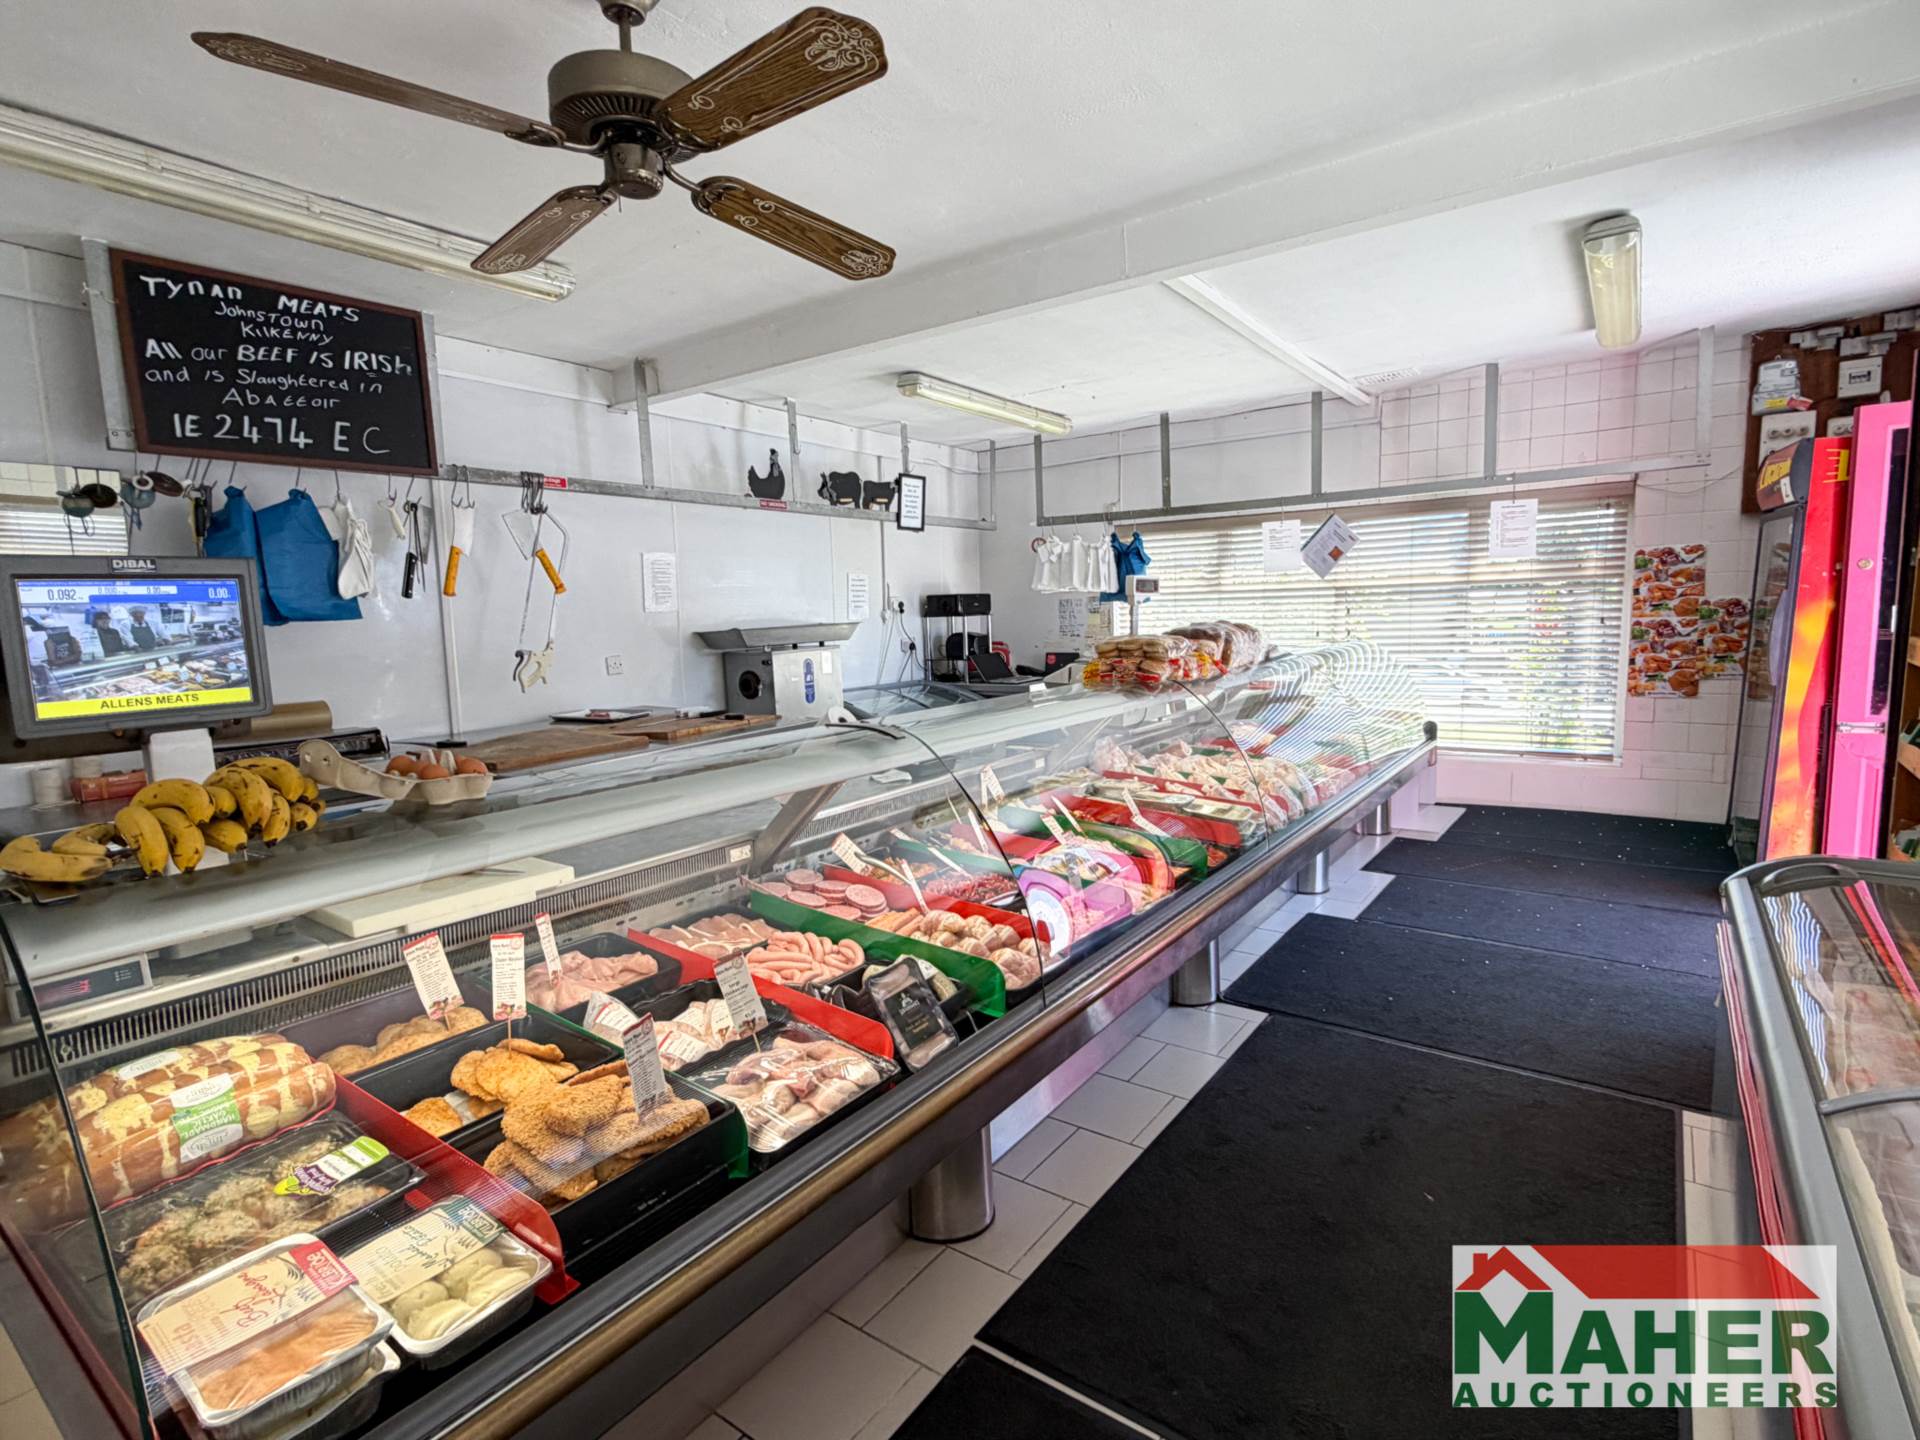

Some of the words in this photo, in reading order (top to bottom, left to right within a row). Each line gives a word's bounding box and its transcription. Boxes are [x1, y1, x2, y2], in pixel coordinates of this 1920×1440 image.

[277, 295, 360, 322] MEATS
[145, 338, 182, 360] All
[191, 346, 228, 361] our
[236, 343, 299, 363] BEEF
[145, 366, 190, 382] and
[236, 368, 349, 391] Slaughtered
[360, 382, 382, 394] in
[213, 413, 313, 449] 2474
[333, 420, 351, 452] E
[362, 426, 390, 454] C
[112, 559, 155, 570] DIBAL
[48, 589, 77, 601] 0.092
[208, 587, 229, 599] 0.00
[100, 695, 153, 710] ALLENS
[156, 693, 200, 705] MEATS
